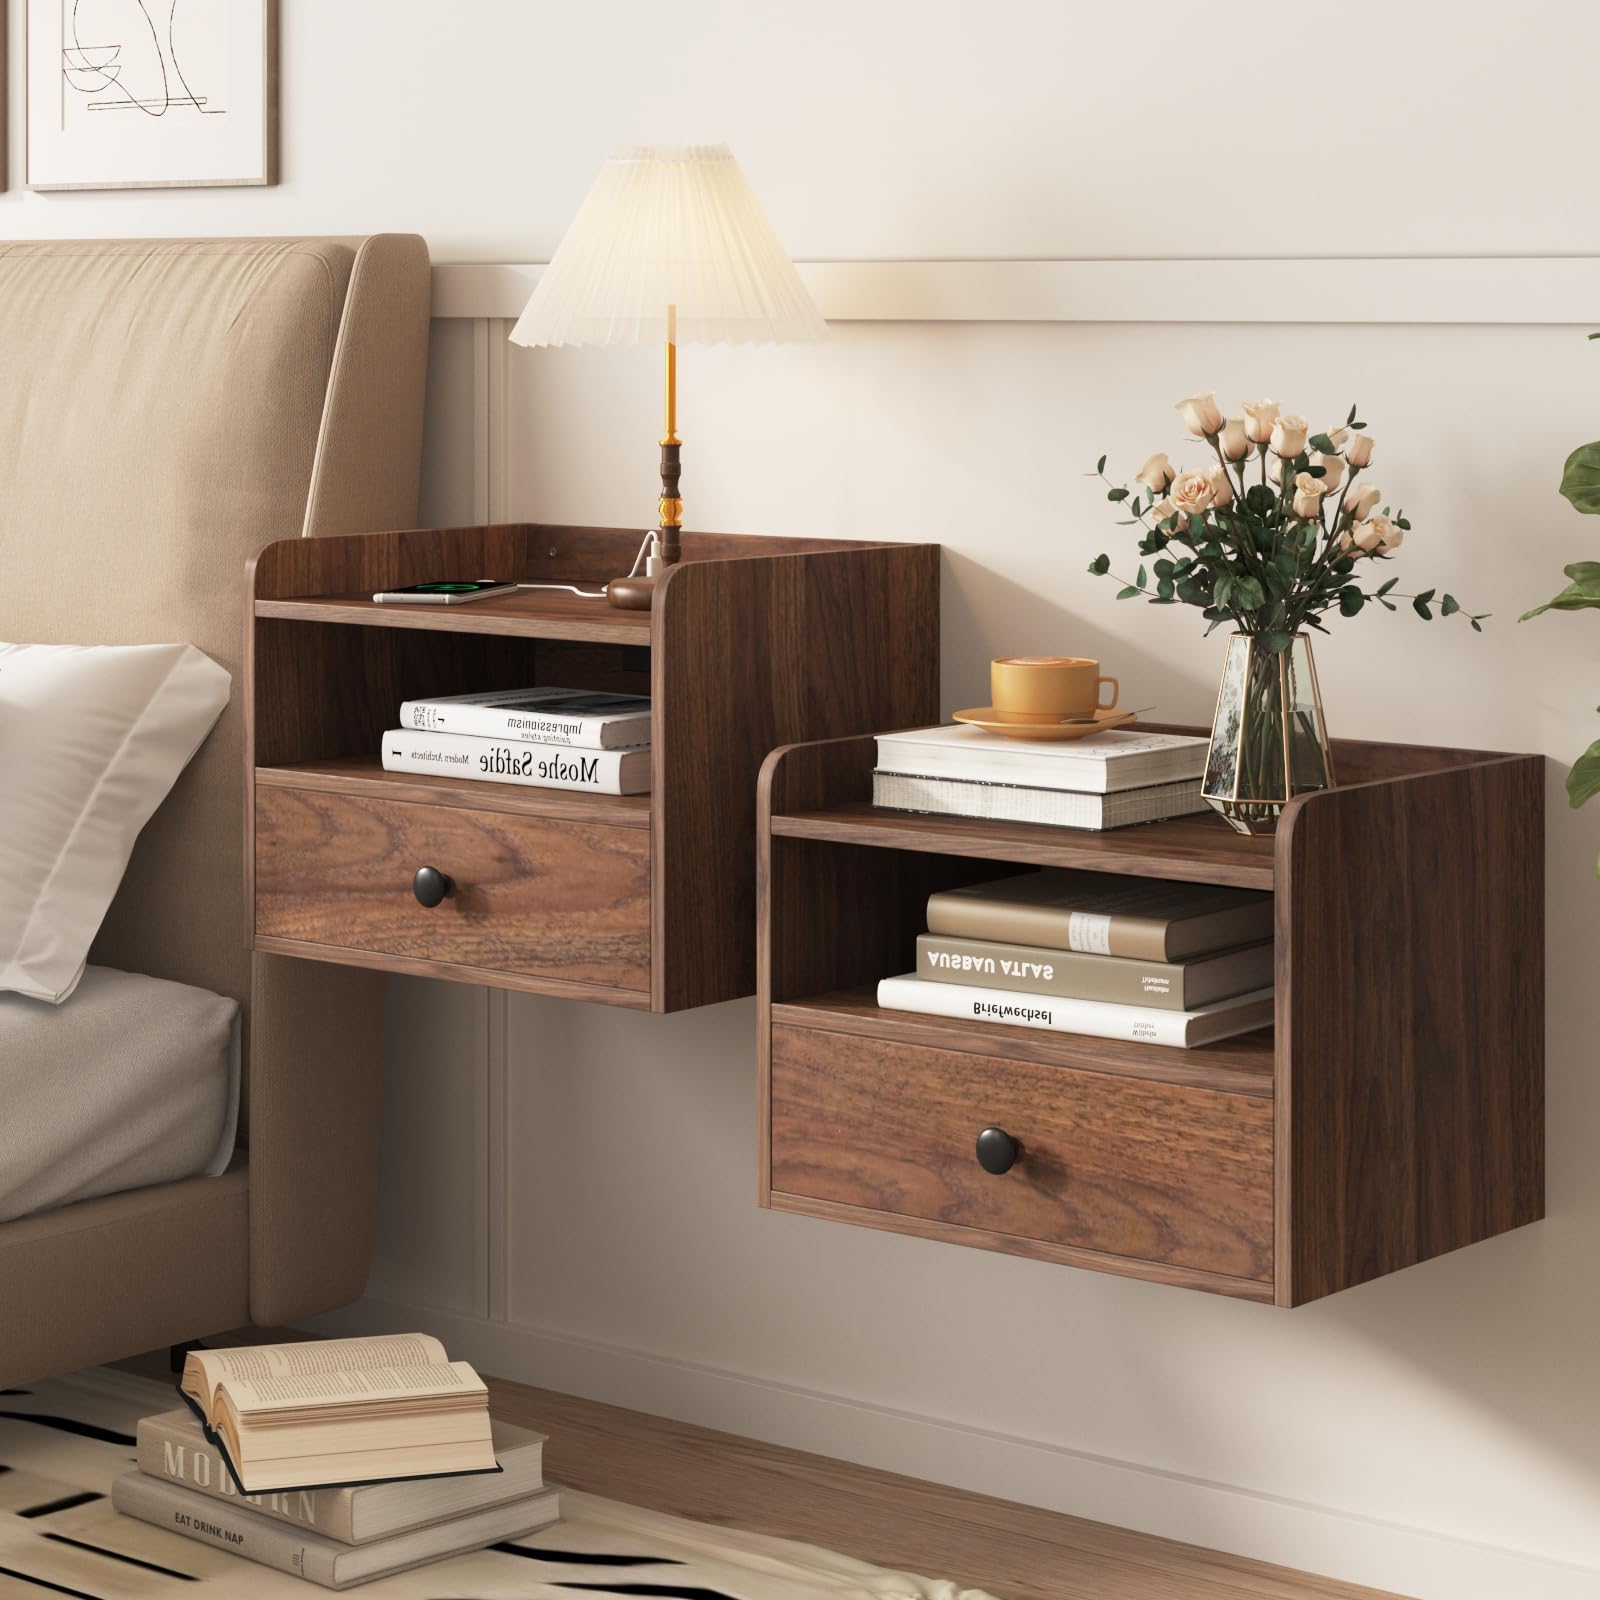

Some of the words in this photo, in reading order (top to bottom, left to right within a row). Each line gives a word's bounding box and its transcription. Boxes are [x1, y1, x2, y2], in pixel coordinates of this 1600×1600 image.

[163, 1440, 316, 1525] MODRN
[174, 1512, 192, 1528] EAT
[194, 1519, 222, 1538] DRINK
[224, 1530, 244, 1545] NAP
